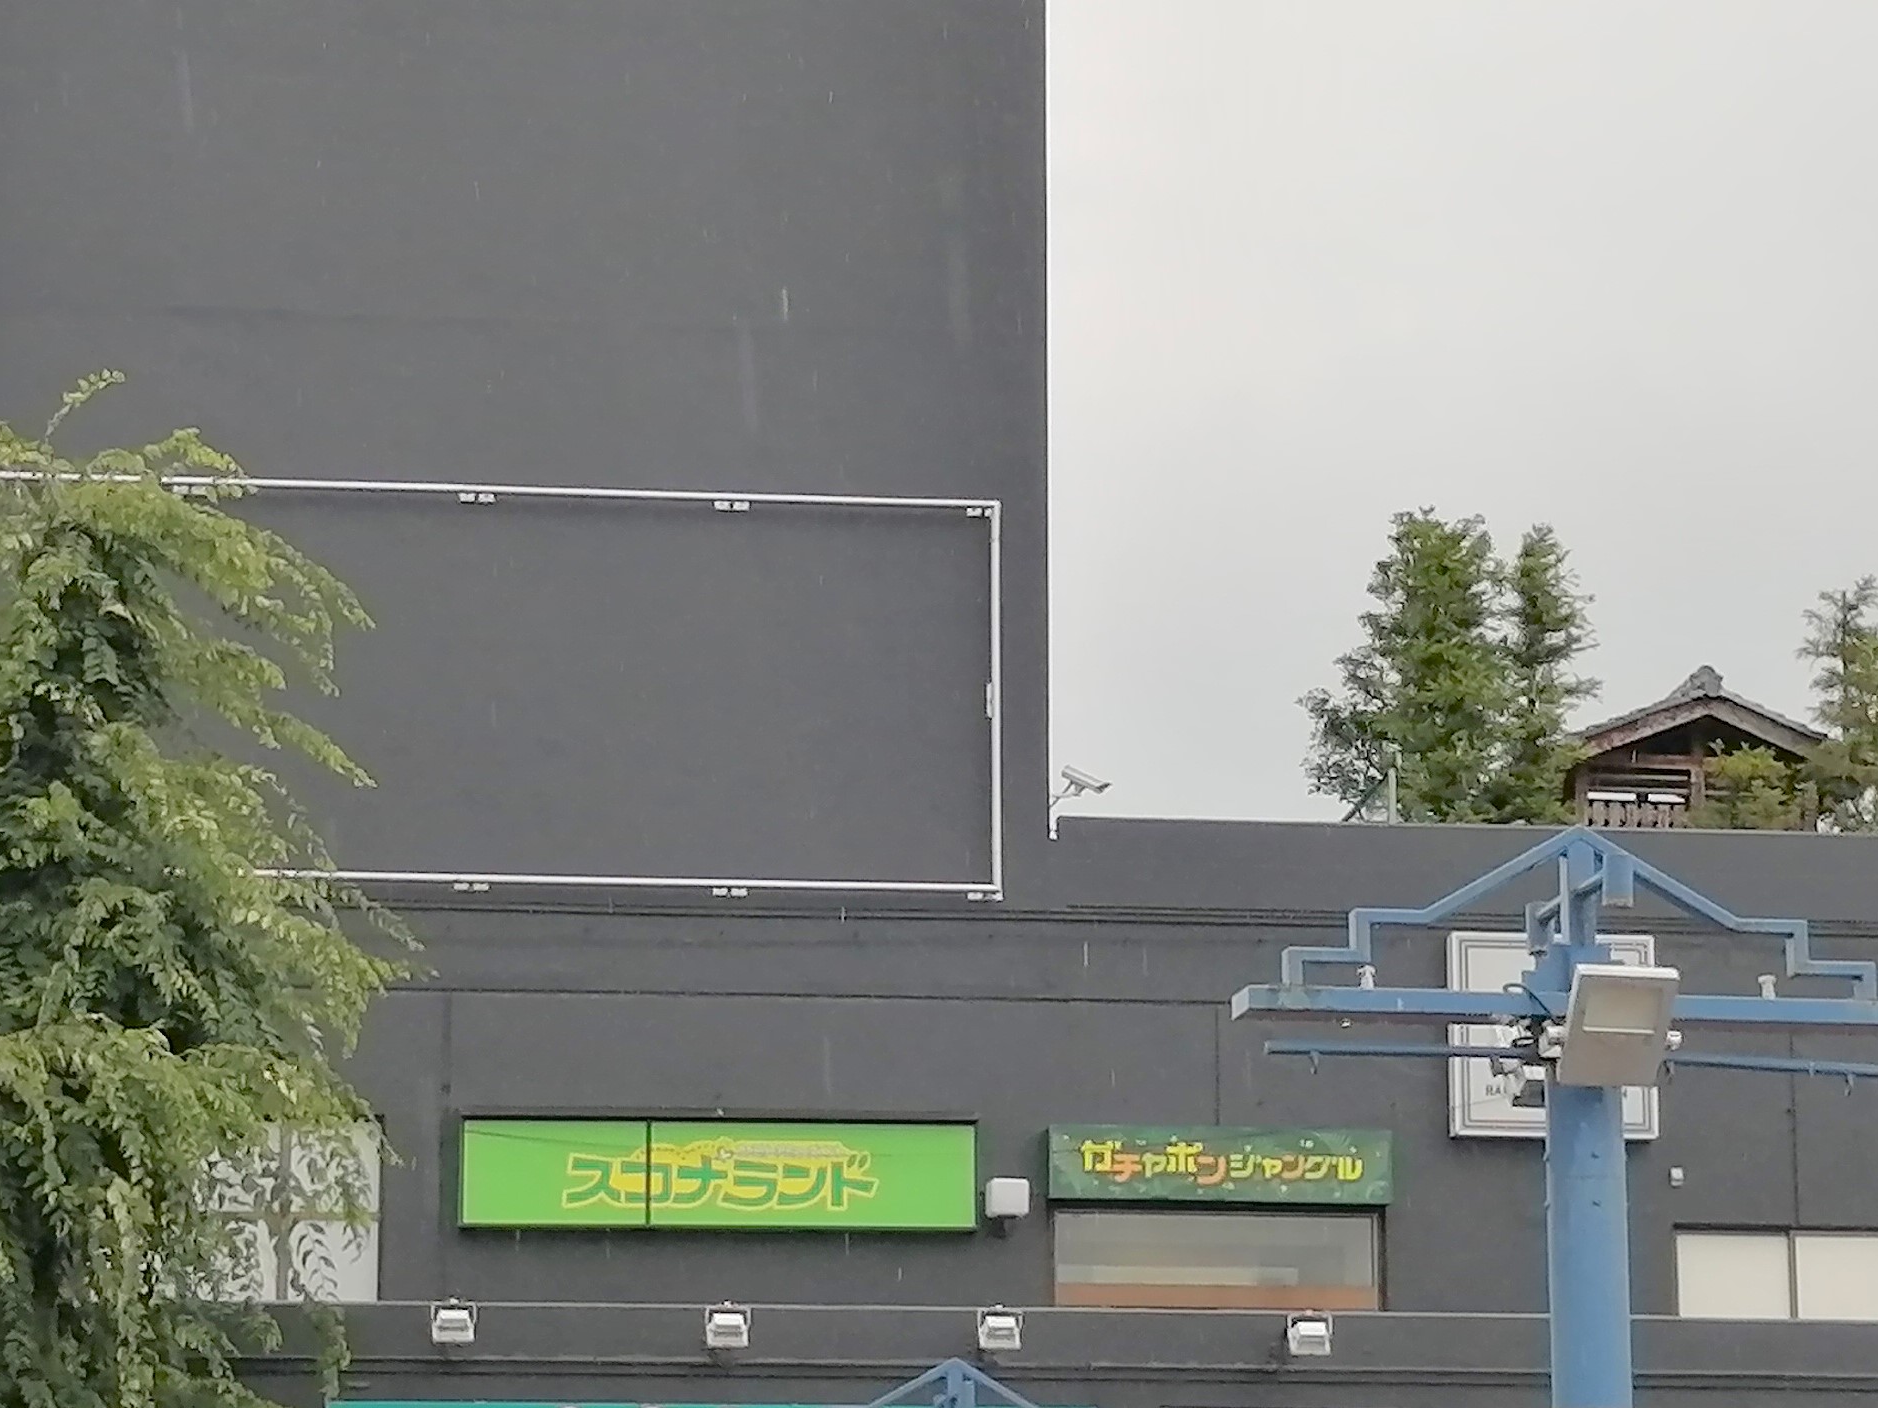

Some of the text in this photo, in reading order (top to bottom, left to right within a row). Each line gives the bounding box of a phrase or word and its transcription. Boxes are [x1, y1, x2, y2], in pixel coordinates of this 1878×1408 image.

[1080, 1140, 1364, 1185] ガチャポンジャングル
